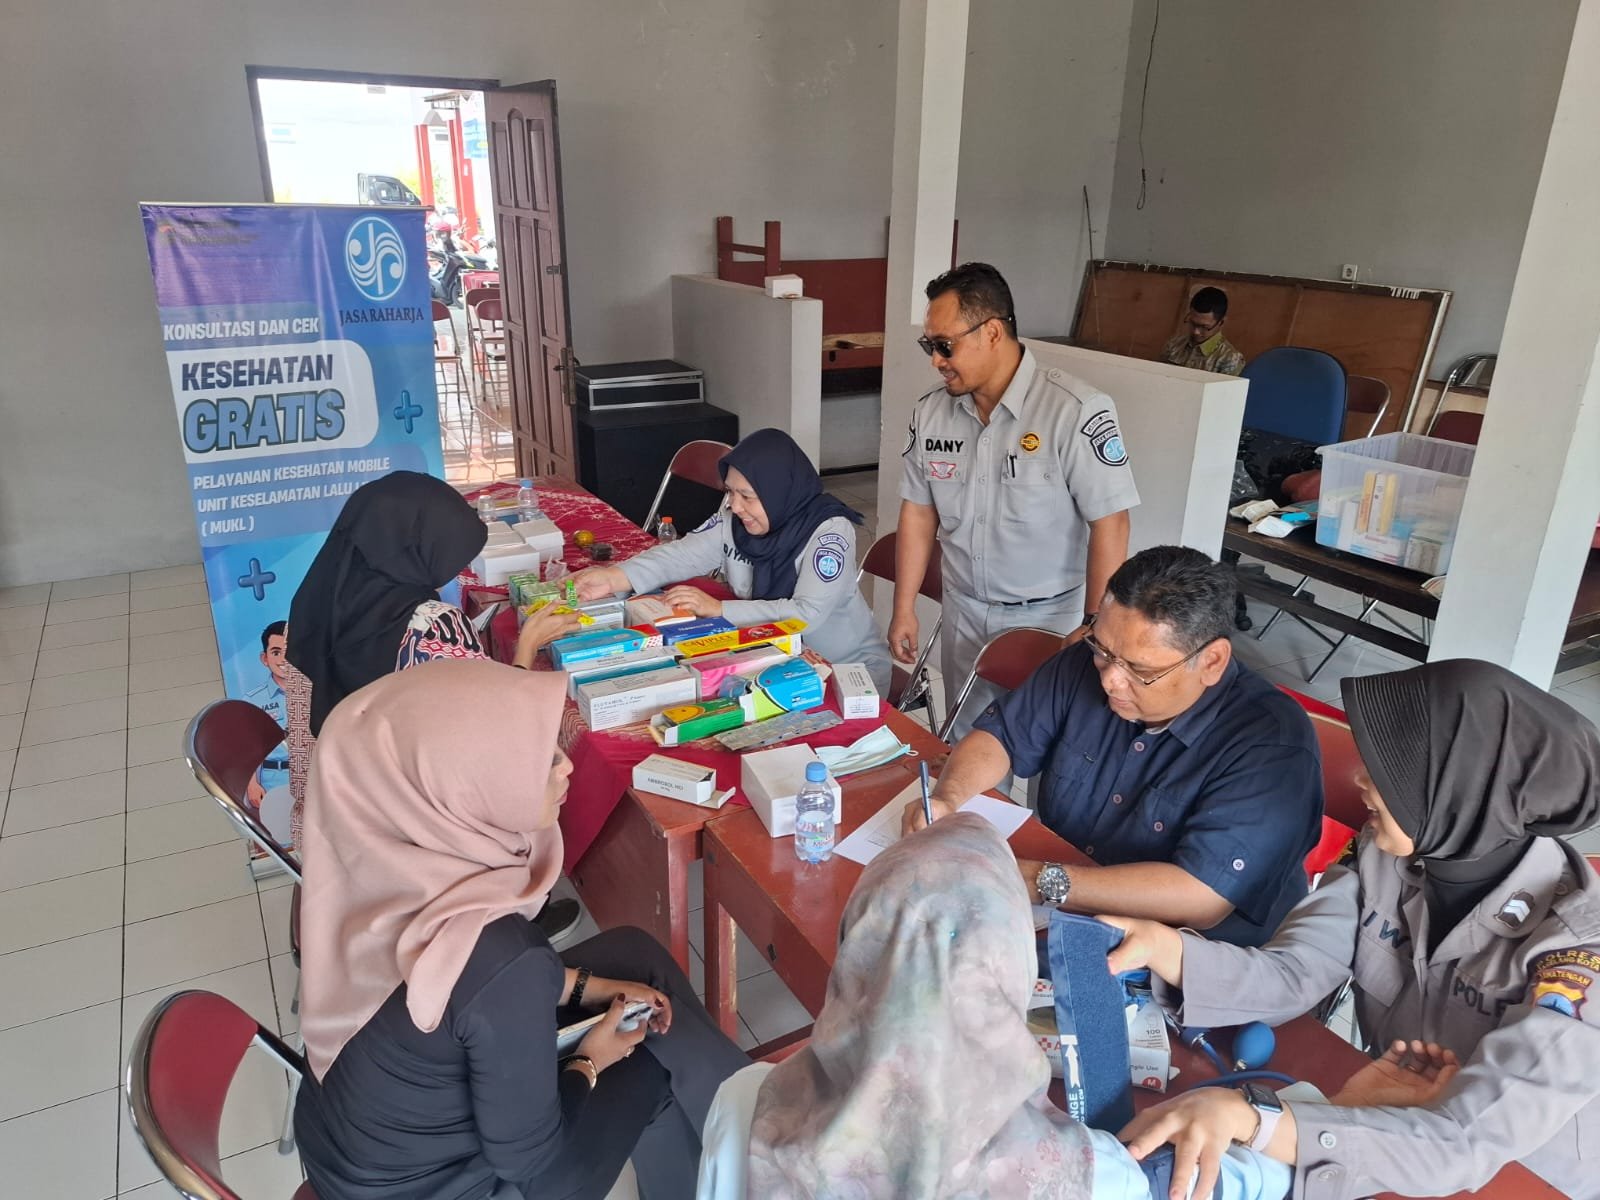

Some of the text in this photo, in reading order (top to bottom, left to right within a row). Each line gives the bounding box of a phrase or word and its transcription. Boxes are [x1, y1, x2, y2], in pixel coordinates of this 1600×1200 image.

[163, 317, 319, 341] KONSULTASI DAN CEK
[339, 307, 424, 326] JASA RAHARJA
[181, 354, 333, 391] KESEHATAN
[183, 388, 345, 454] GRATIS
[925, 439, 964, 453] DANY
[194, 457, 390, 490] PELAYANAN KESEHATAN MOBILE
[198, 496, 228, 513] UNIT
[230, 487, 321, 509] KESELAMATAN
[323, 482, 353, 497] LALU
[210, 518, 247, 535] MUKL
